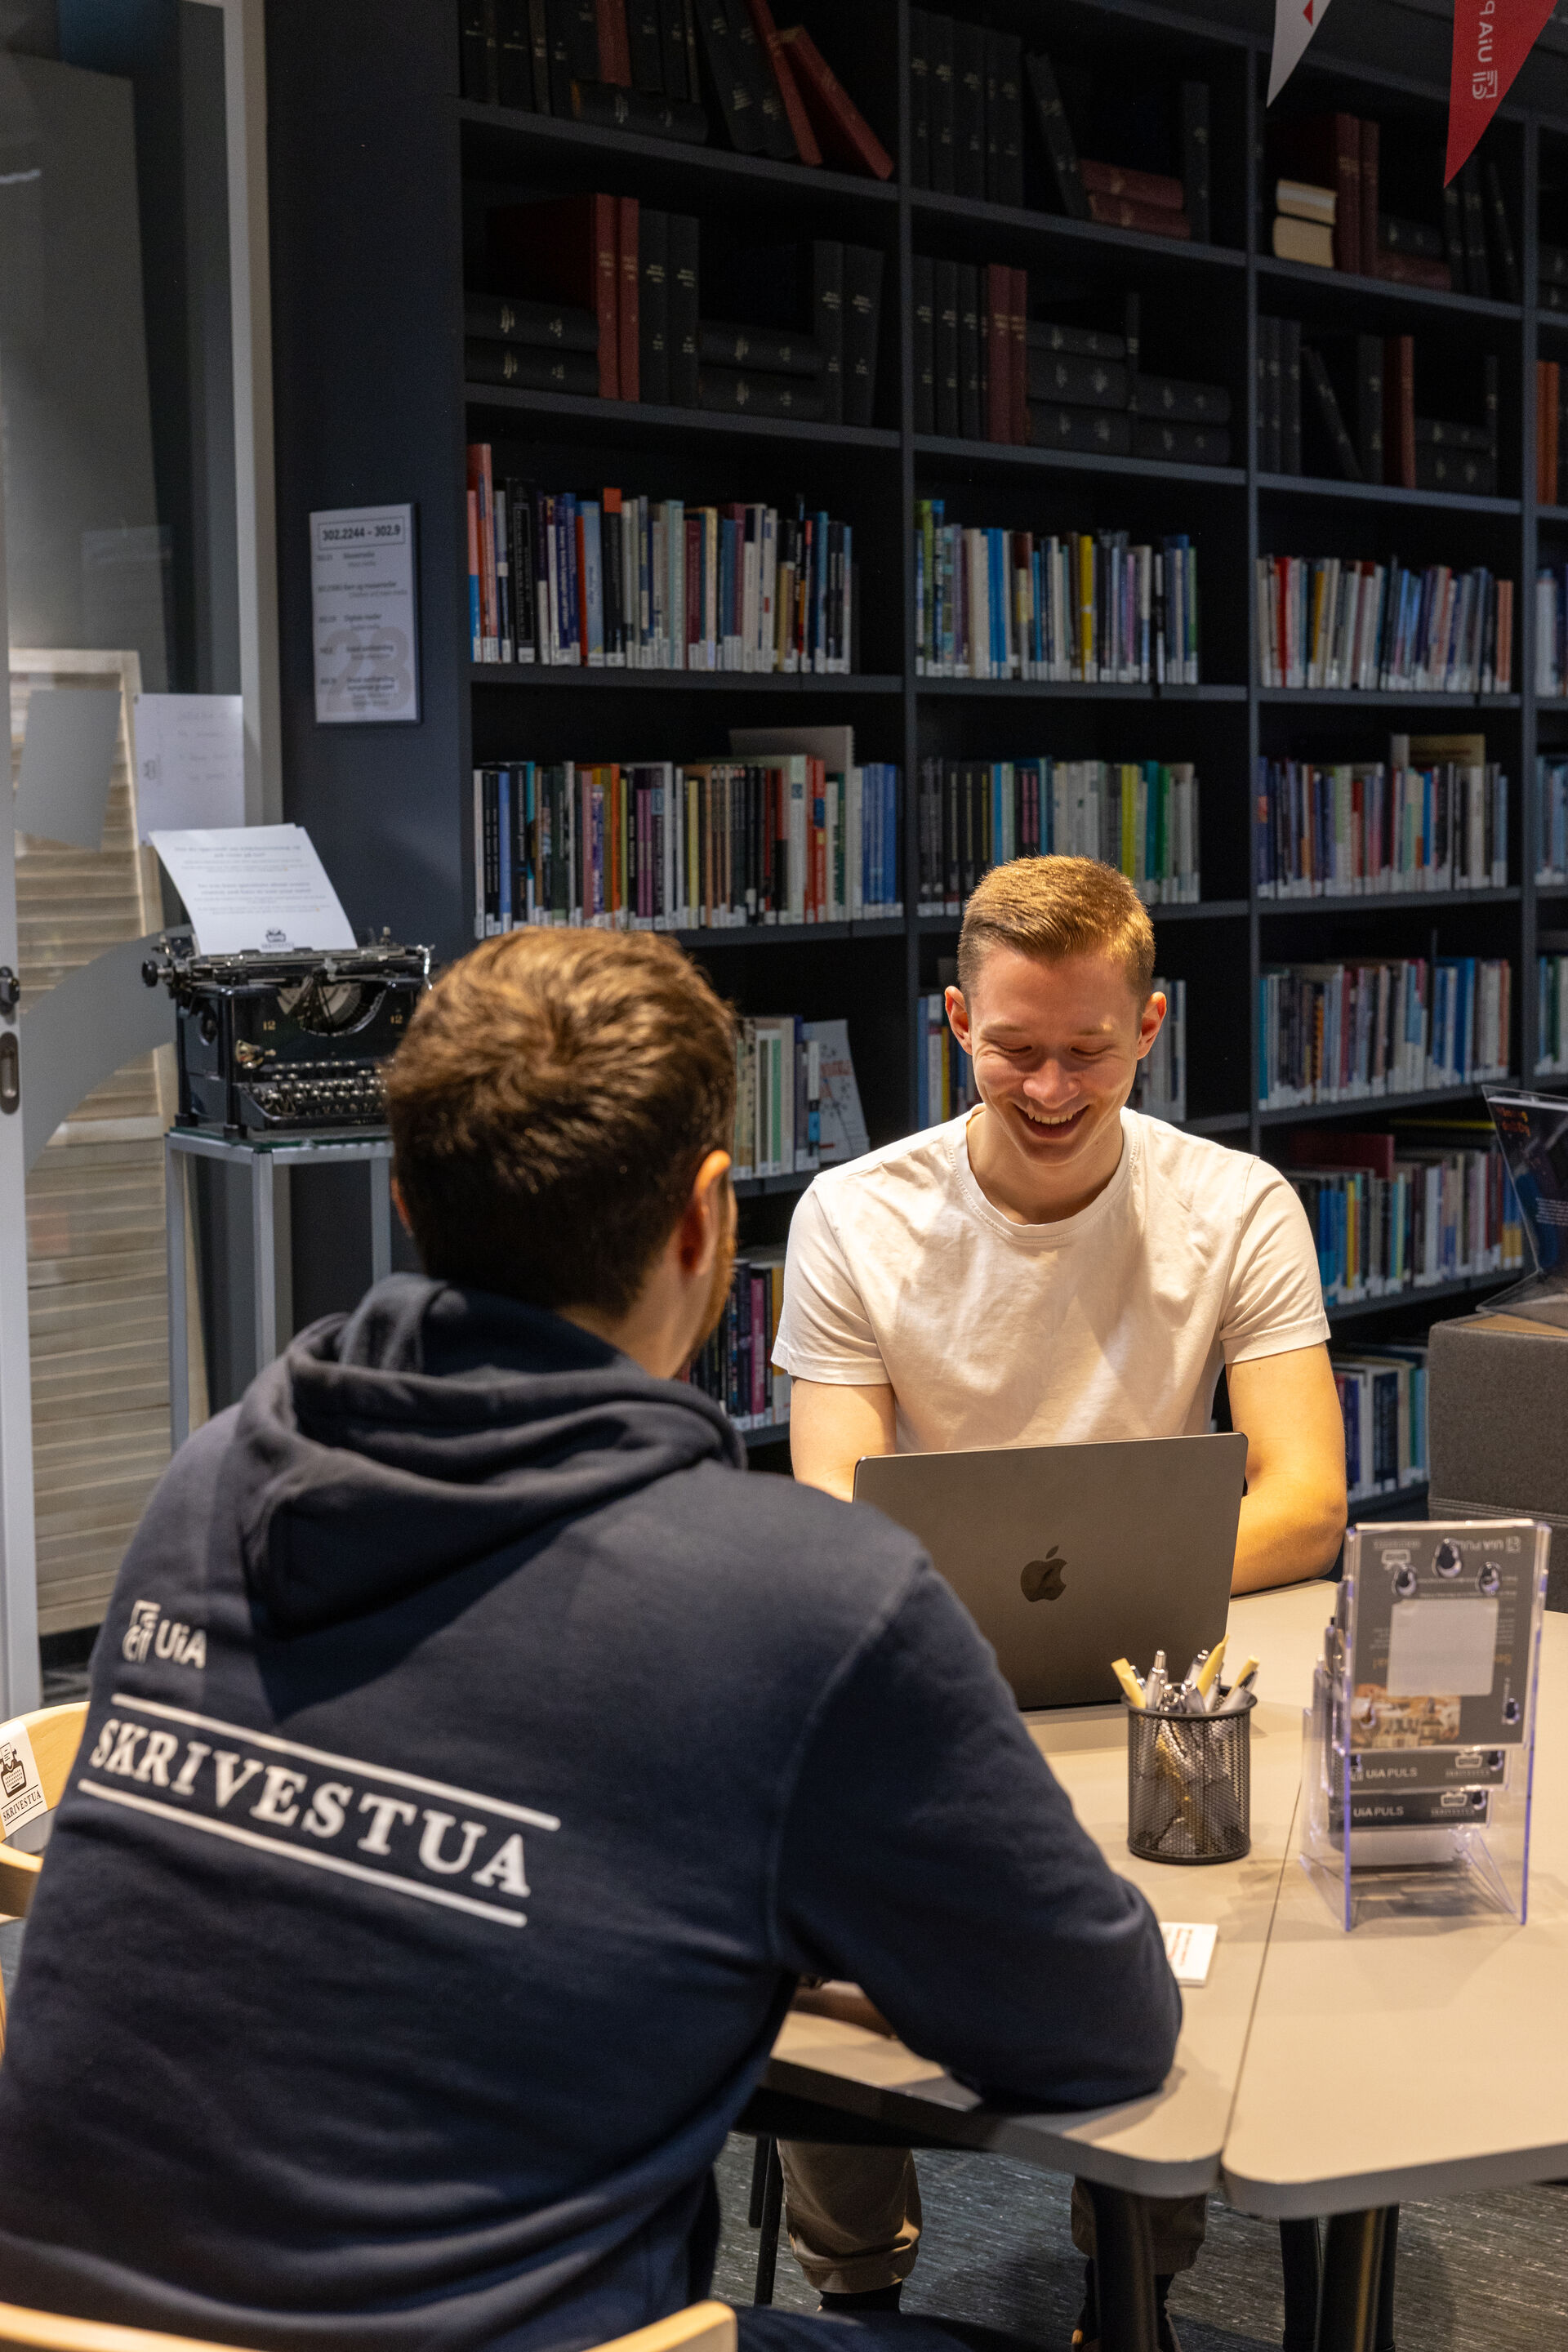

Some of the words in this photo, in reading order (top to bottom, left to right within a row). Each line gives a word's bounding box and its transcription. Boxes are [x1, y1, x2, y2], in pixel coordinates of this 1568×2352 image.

[1478, 21, 1493, 62] UiA
[323, 528, 365, 541] 302.2244
[375, 524, 401, 537] 302.9
[262, 1020, 276, 1031] 12
[390, 1014, 403, 1025] 12
[154, 1620, 207, 1669] UiA
[1365, 1768, 1386, 1780] UiA
[1388, 1766, 1418, 1779] PULS
[2, 1789, 42, 1822] SKRIVESTUA
[90, 1718, 531, 1898] SKRIVESTUA
[1374, 1805, 1405, 1816] PULS
